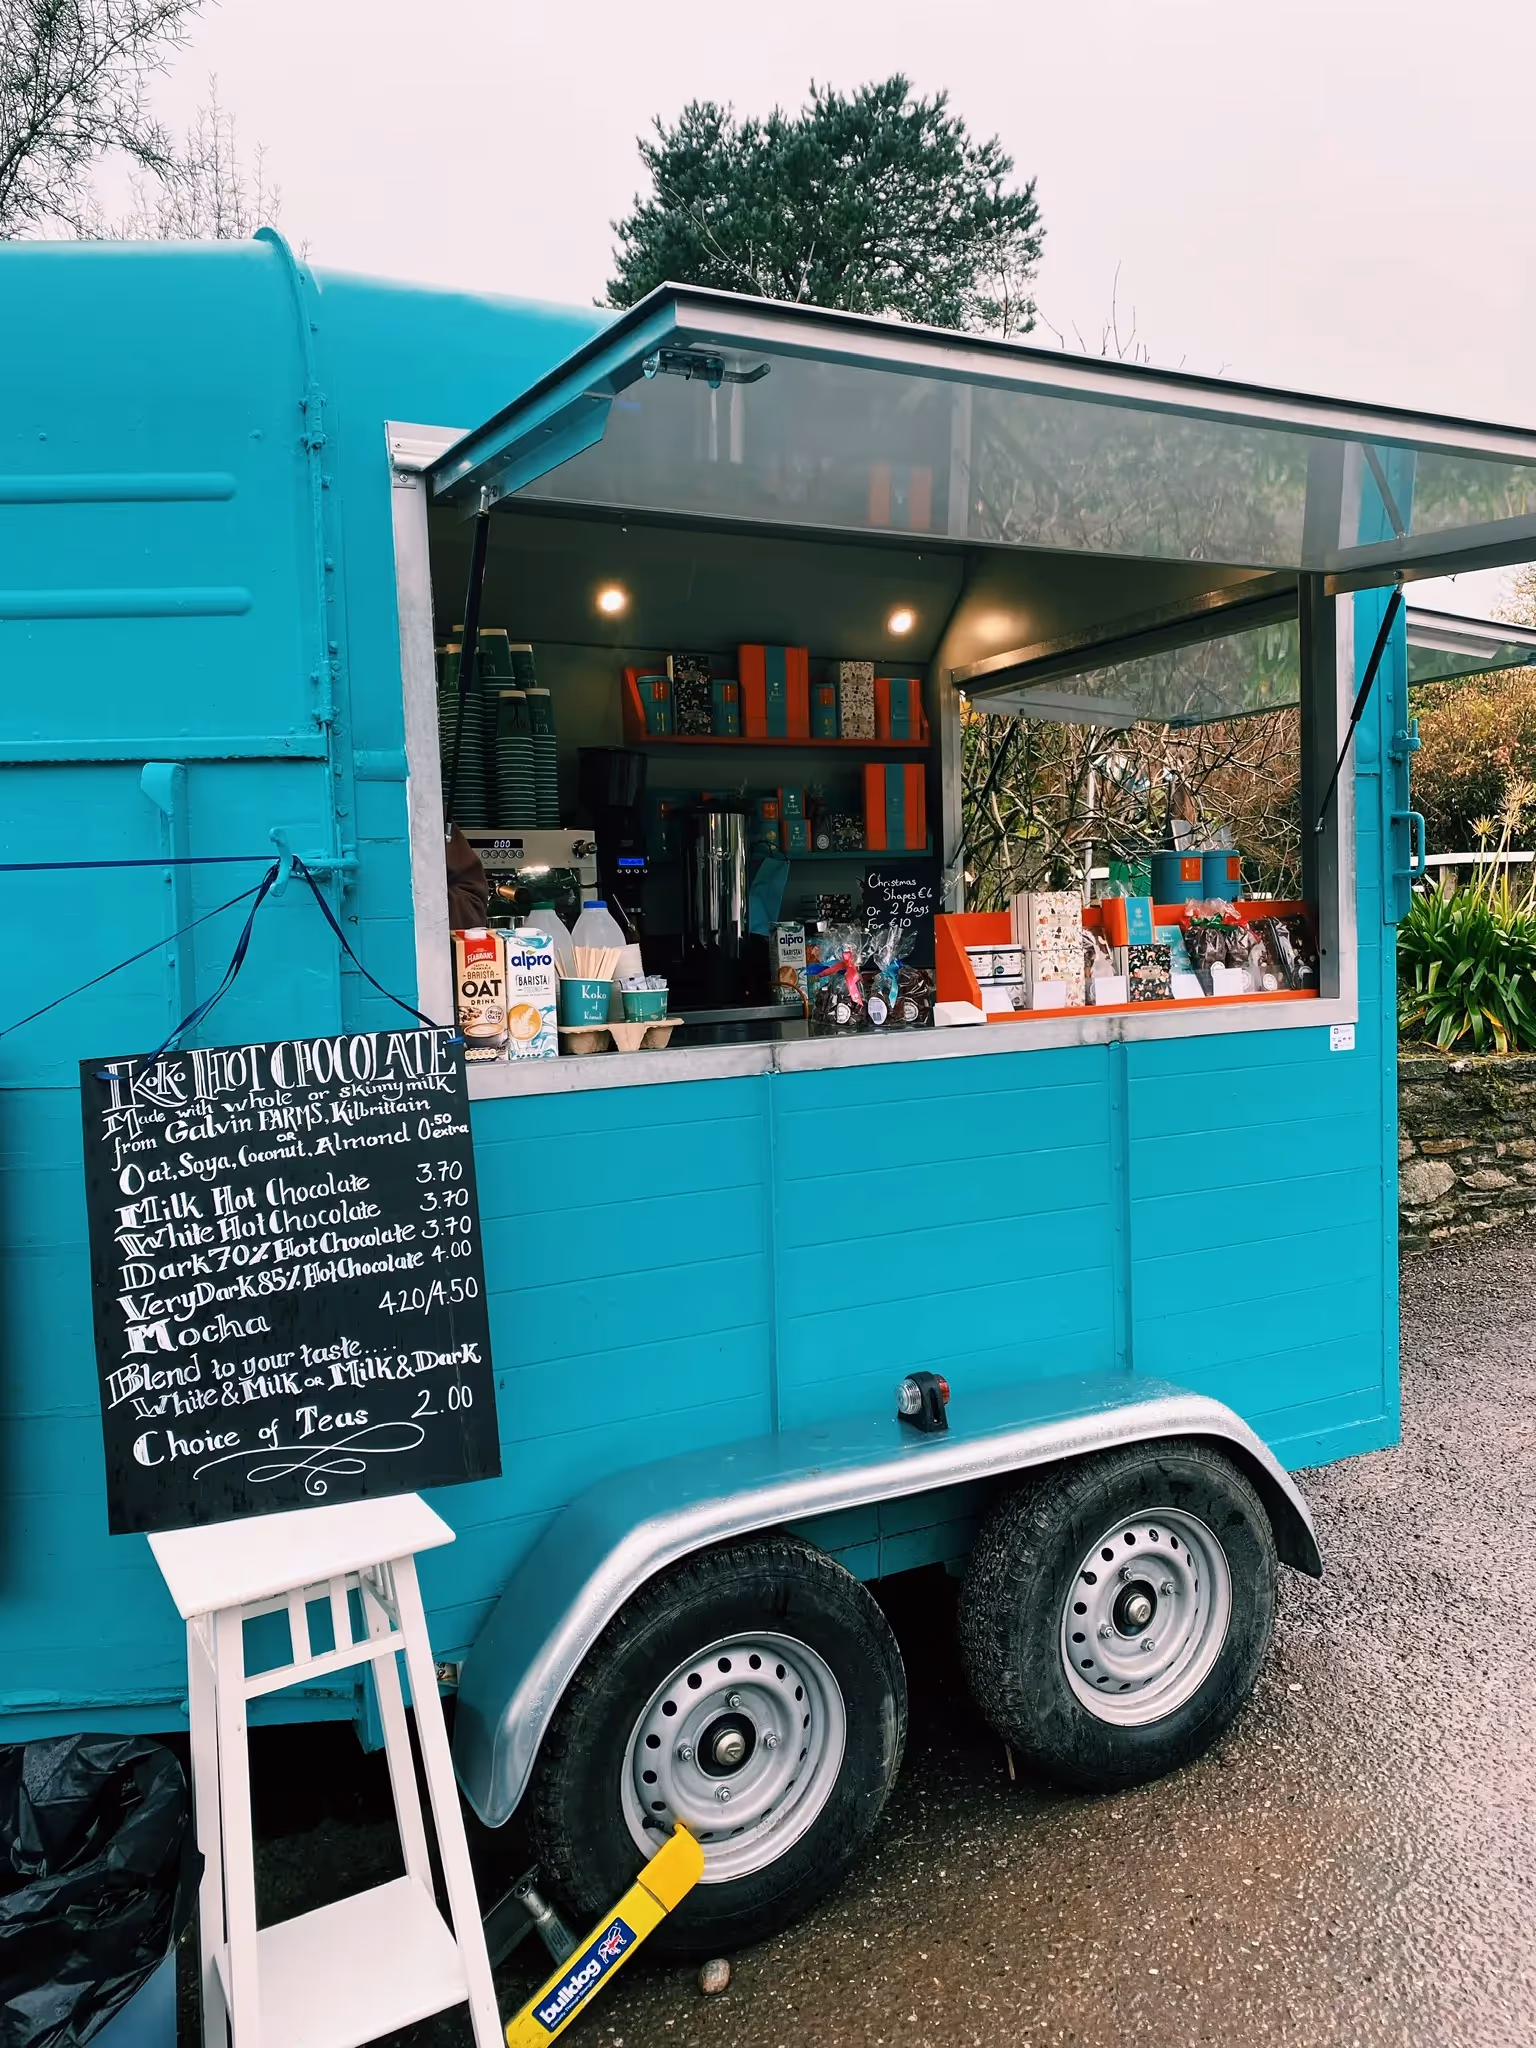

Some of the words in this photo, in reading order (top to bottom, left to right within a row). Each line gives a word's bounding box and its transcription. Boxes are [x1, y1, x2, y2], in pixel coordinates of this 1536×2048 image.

[866, 906, 881, 916] Or
[889, 902, 899, 915] 2
[905, 901, 930, 917] Bags
[867, 873, 917, 889] Christmas
[883, 888, 917, 902] Shapes
[917, 890, 933, 900] €6
[779, 935, 803, 946] alpro
[867, 919, 884, 930] For
[462, 979, 502, 998] OAT
[467, 970, 495, 979] BARISTA
[511, 951, 552, 970] alpro
[518, 975, 548, 986] BARISTA
[581, 985, 607, 999] Koko
[187, 1043, 266, 1100] HOT
[271, 1027, 457, 1089] CHOCOLATE
[102, 1108, 166, 1141] Made
[175, 1099, 214, 1118] with
[221, 1090, 292, 1113] whole
[308, 1089, 330, 1101] or
[338, 1080, 404, 1101] skinny
[406, 1075, 456, 1094] milk
[111, 1137, 157, 1172] from
[165, 1113, 253, 1144] Galvin
[329, 1097, 431, 1126] Kilbrittain
[119, 1162, 177, 1195] Oat,
[178, 1152, 237, 1182] Soya,
[315, 1121, 411, 1157] Almond
[432, 1124, 470, 1139] extra
[114, 1192, 203, 1234] Milk
[211, 1185, 257, 1216] Hot
[266, 1172, 370, 1206] Chocolate
[416, 1160, 463, 1183] 3.70
[114, 1223, 215, 1261] White
[217, 1213, 267, 1243] Hot
[269, 1200, 381, 1234] Chocolate
[420, 1188, 468, 1211] 3.70
[116, 1291, 196, 1324] Very
[194, 1275, 260, 1307] Dark
[258, 1264, 301, 1296] 85%
[303, 1260, 338, 1291] Hot
[338, 1251, 424, 1279] Chocolate
[431, 1240, 471, 1263] 4.00
[118, 1254, 212, 1291] Dark
[208, 1242, 272, 1272] 70%
[273, 1237, 320, 1263] Hot
[320, 1224, 416, 1254] Chocolate
[421, 1216, 471, 1239] 3.70
[121, 1313, 271, 1359] Mocha
[379, 1276, 478, 1315] 4.20/4.50
[105, 1353, 201, 1409] Blend
[211, 1359, 235, 1380] to
[238, 1352, 296, 1381] your
[130, 1388, 218, 1420] White
[221, 1381, 240, 1406] &
[238, 1373, 303, 1404] Milk
[328, 1357, 395, 1391] Milk
[396, 1355, 415, 1379] &
[411, 1343, 481, 1373] Dark
[133, 1429, 240, 1466] Choice
[258, 1418, 279, 1448] of
[296, 1406, 369, 1439] Teas
[411, 1385, 473, 1418] 2.00
[539, 1958, 601, 2024] bulldog
